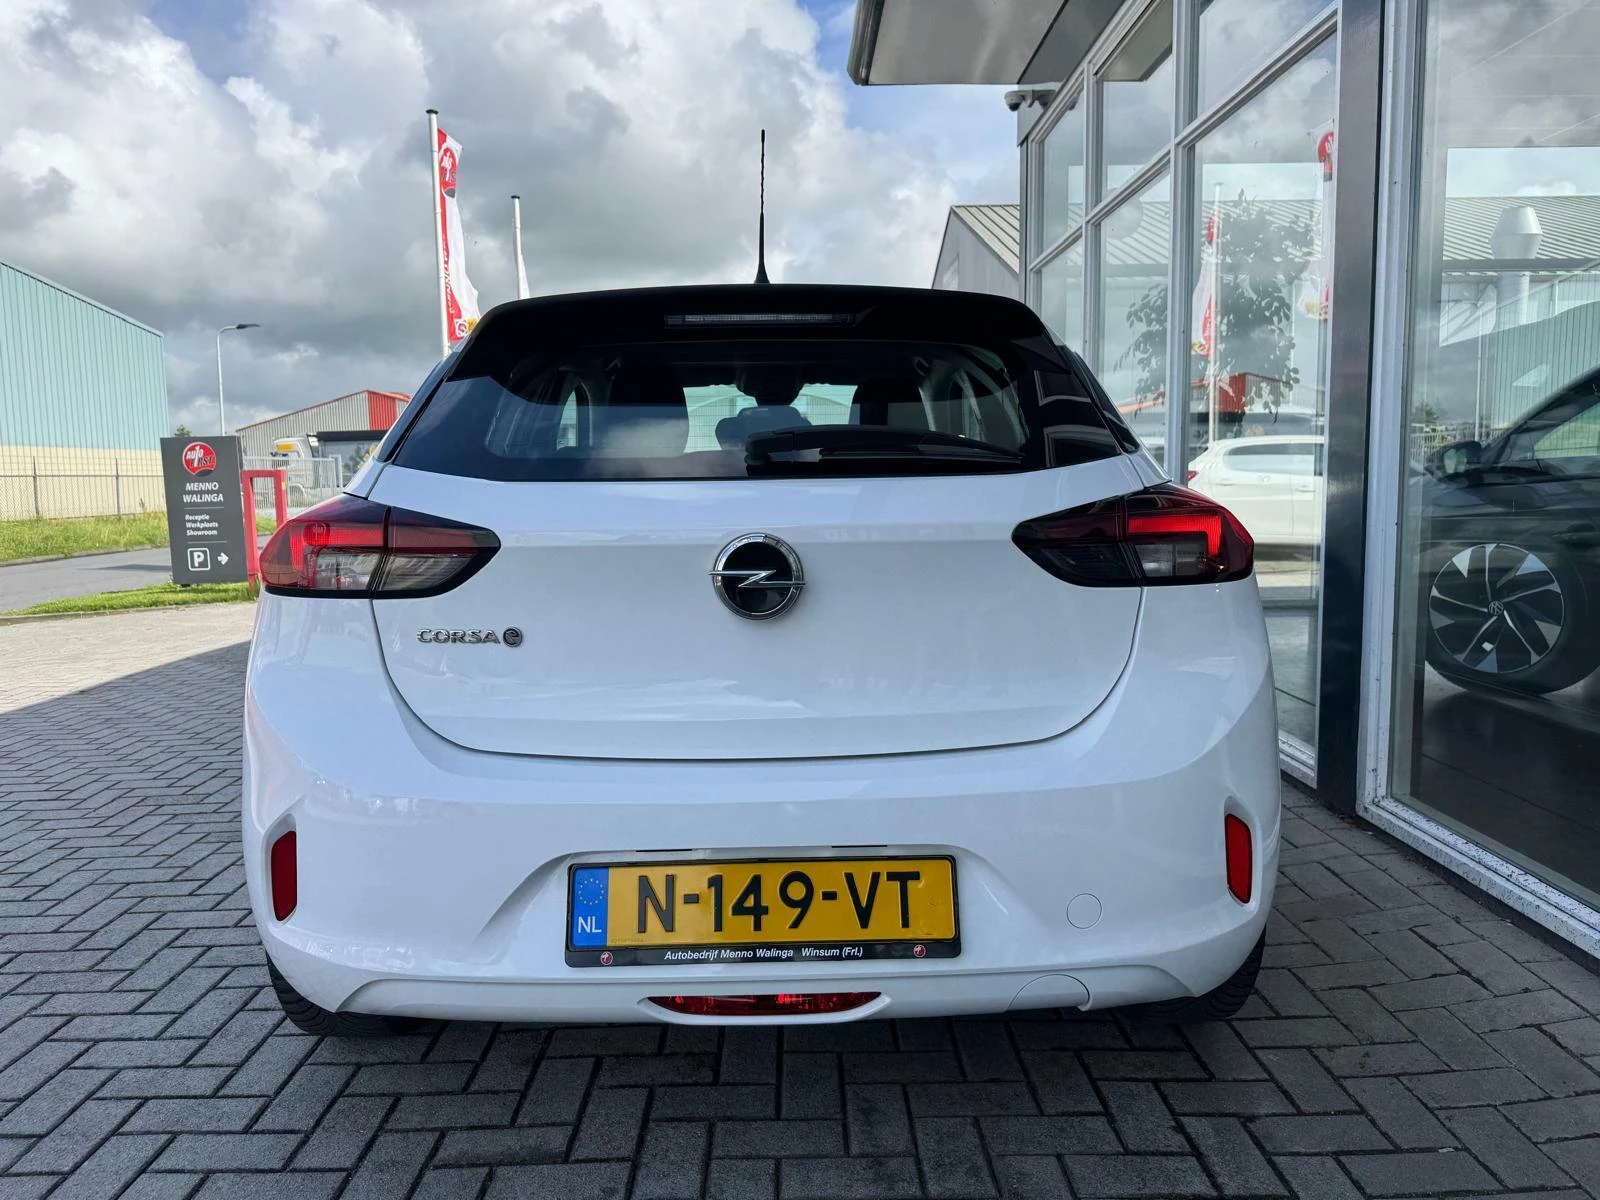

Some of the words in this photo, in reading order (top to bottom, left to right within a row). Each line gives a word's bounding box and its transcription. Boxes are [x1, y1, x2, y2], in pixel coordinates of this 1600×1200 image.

[185, 482, 219, 491] MENNO
[182, 493, 224, 503] WALINGA
[186, 521, 218, 529] Werkplaats
[193, 552, 205, 567] P
[417, 628, 501, 644] CORSA
[637, 870, 921, 934] N-149-VT
[577, 916, 602, 934] NL
[664, 949, 719, 961] Autobedrijf
[720, 949, 754, 959] Menno
[755, 948, 794, 959] Walinga
[801, 946, 841, 957] Winsum
